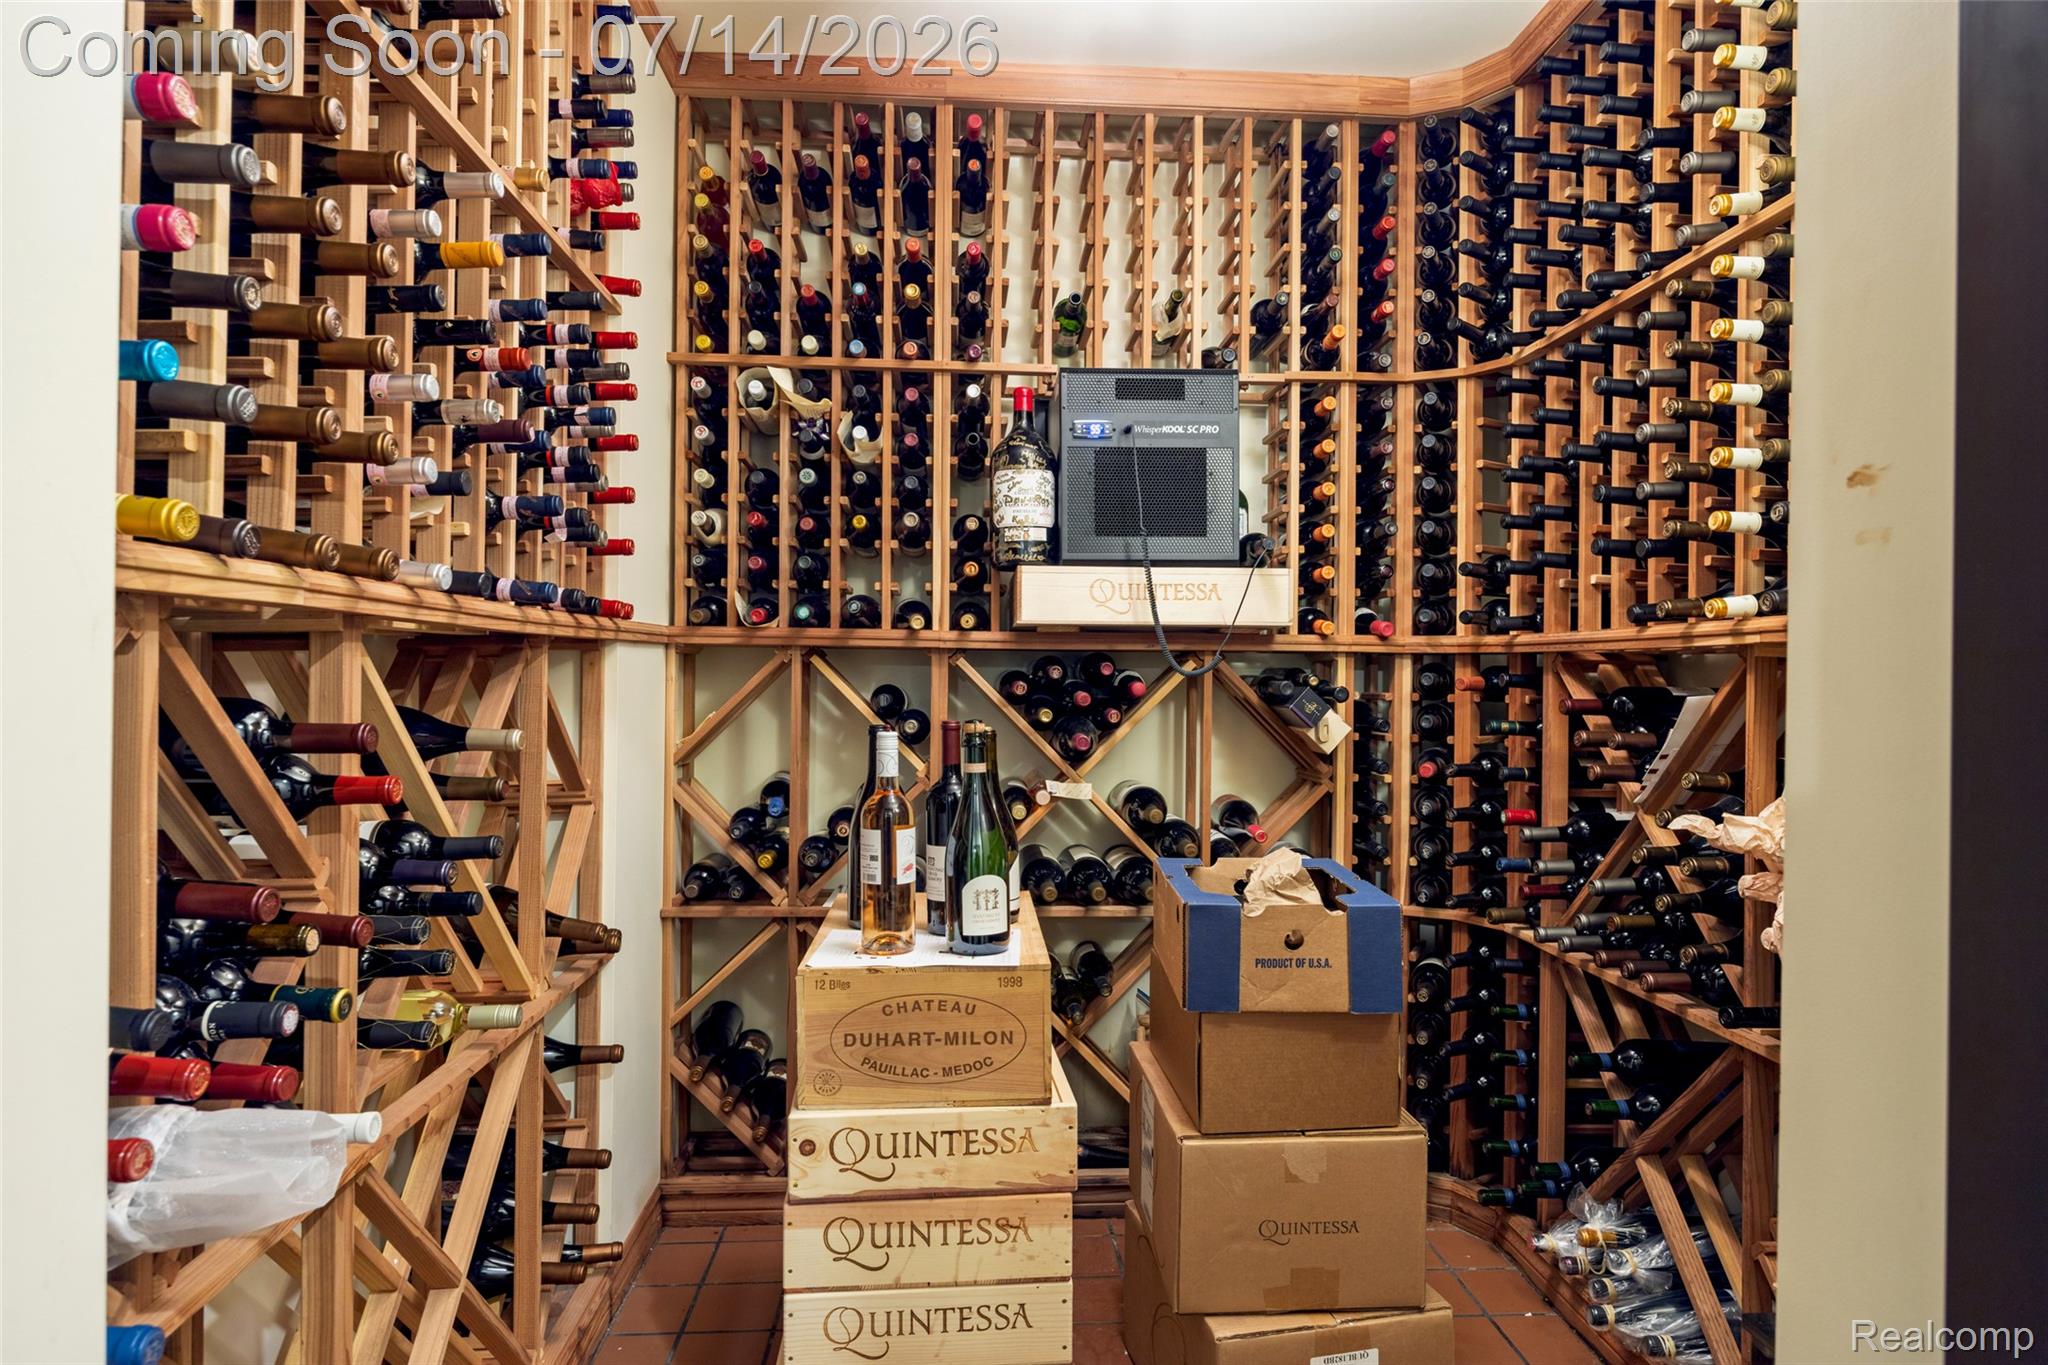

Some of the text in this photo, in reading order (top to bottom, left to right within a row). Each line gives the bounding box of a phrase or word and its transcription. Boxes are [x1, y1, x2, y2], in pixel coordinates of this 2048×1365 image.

[1187, 425, 1199, 434] SC
[1200, 425, 1220, 434] PRO
[1255, 958, 1332, 968] PRODUCT OF U.S.A.
[815, 979, 826, 991] 12
[998, 976, 1023, 989] 1998
[882, 999, 978, 1017] CHATEAU
[843, 1030, 1014, 1048] DUHART-MILON
[860, 1056, 930, 1079] PAUILLAC
[942, 1056, 995, 1078] MEDOC
[829, 1126, 1039, 1183] QUINTESSA
[1258, 1219, 1360, 1246] QUINTESSA
[823, 1216, 1034, 1272] QUINTESSA
[823, 1302, 1034, 1361] QUINTESSA
